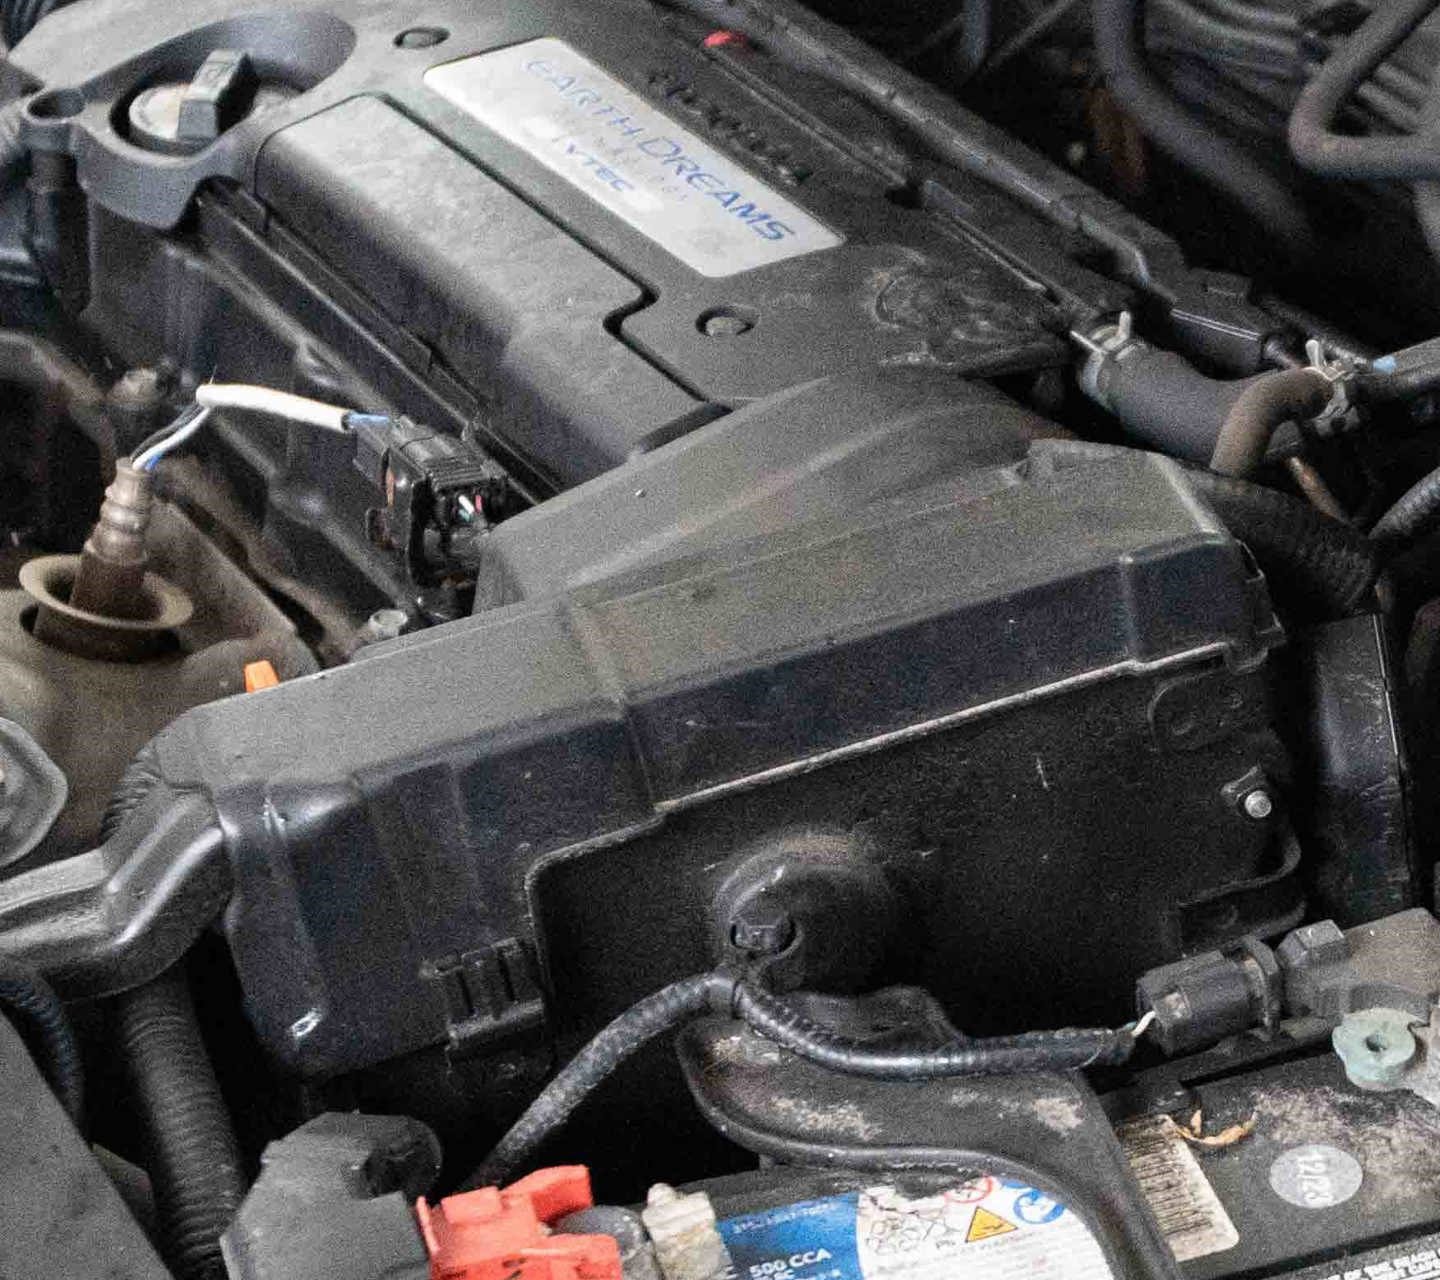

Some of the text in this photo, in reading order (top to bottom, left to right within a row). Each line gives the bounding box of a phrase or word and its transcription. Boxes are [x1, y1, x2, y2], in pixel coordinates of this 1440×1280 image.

[526, 60, 641, 139] EARTH
[639, 134, 796, 243] DREAMS
[1296, 1153, 1335, 1204] 12/23
[749, 1247, 833, 1277] 500 CCA
